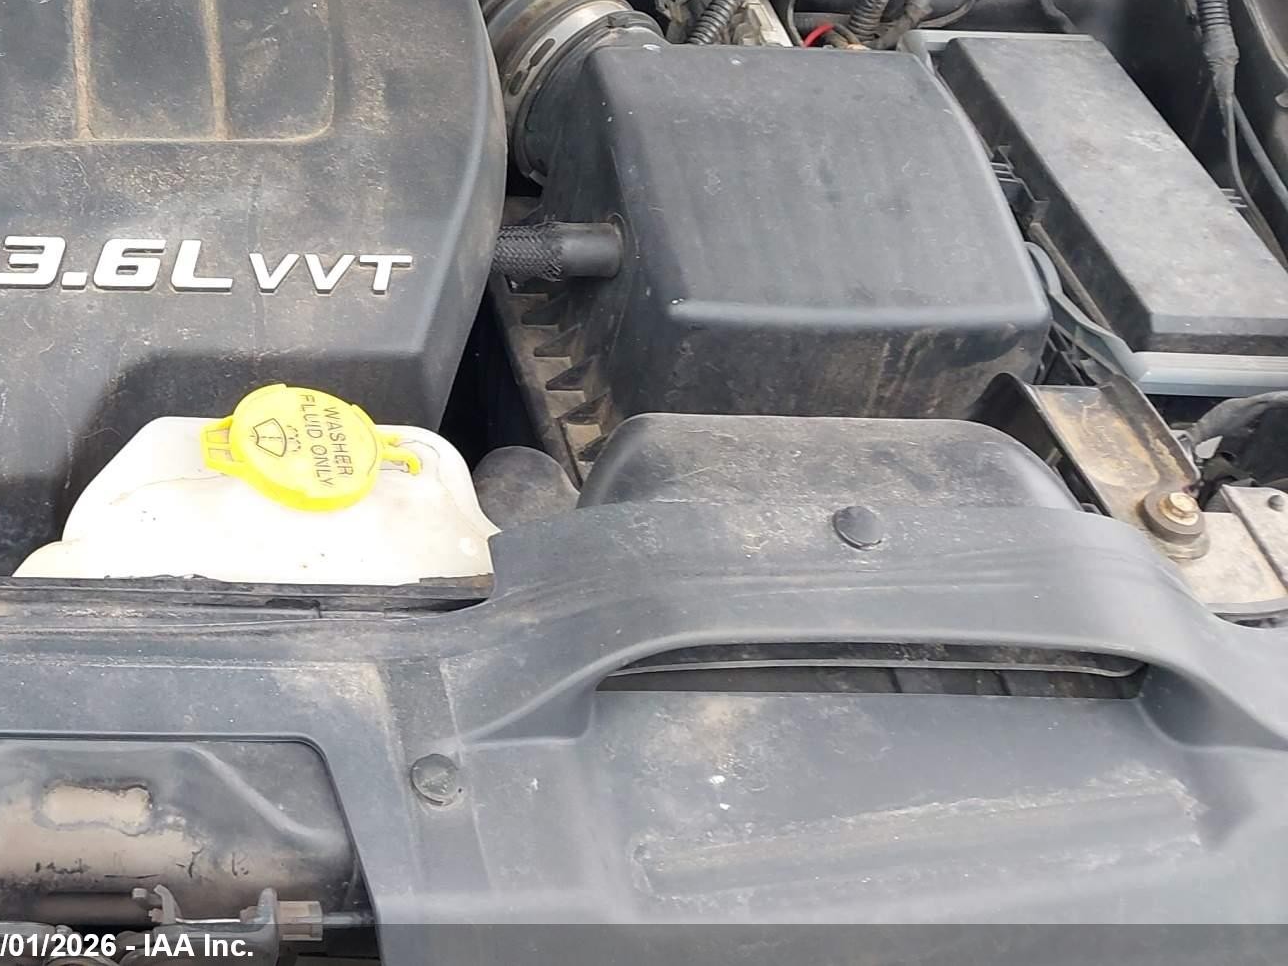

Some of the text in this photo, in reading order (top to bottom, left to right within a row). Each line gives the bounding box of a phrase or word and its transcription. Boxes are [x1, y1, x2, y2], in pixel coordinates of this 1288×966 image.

[249, 252, 412, 295] VVT
[298, 394, 334, 488] FLUID ONLY
[323, 406, 354, 476] WASHER
